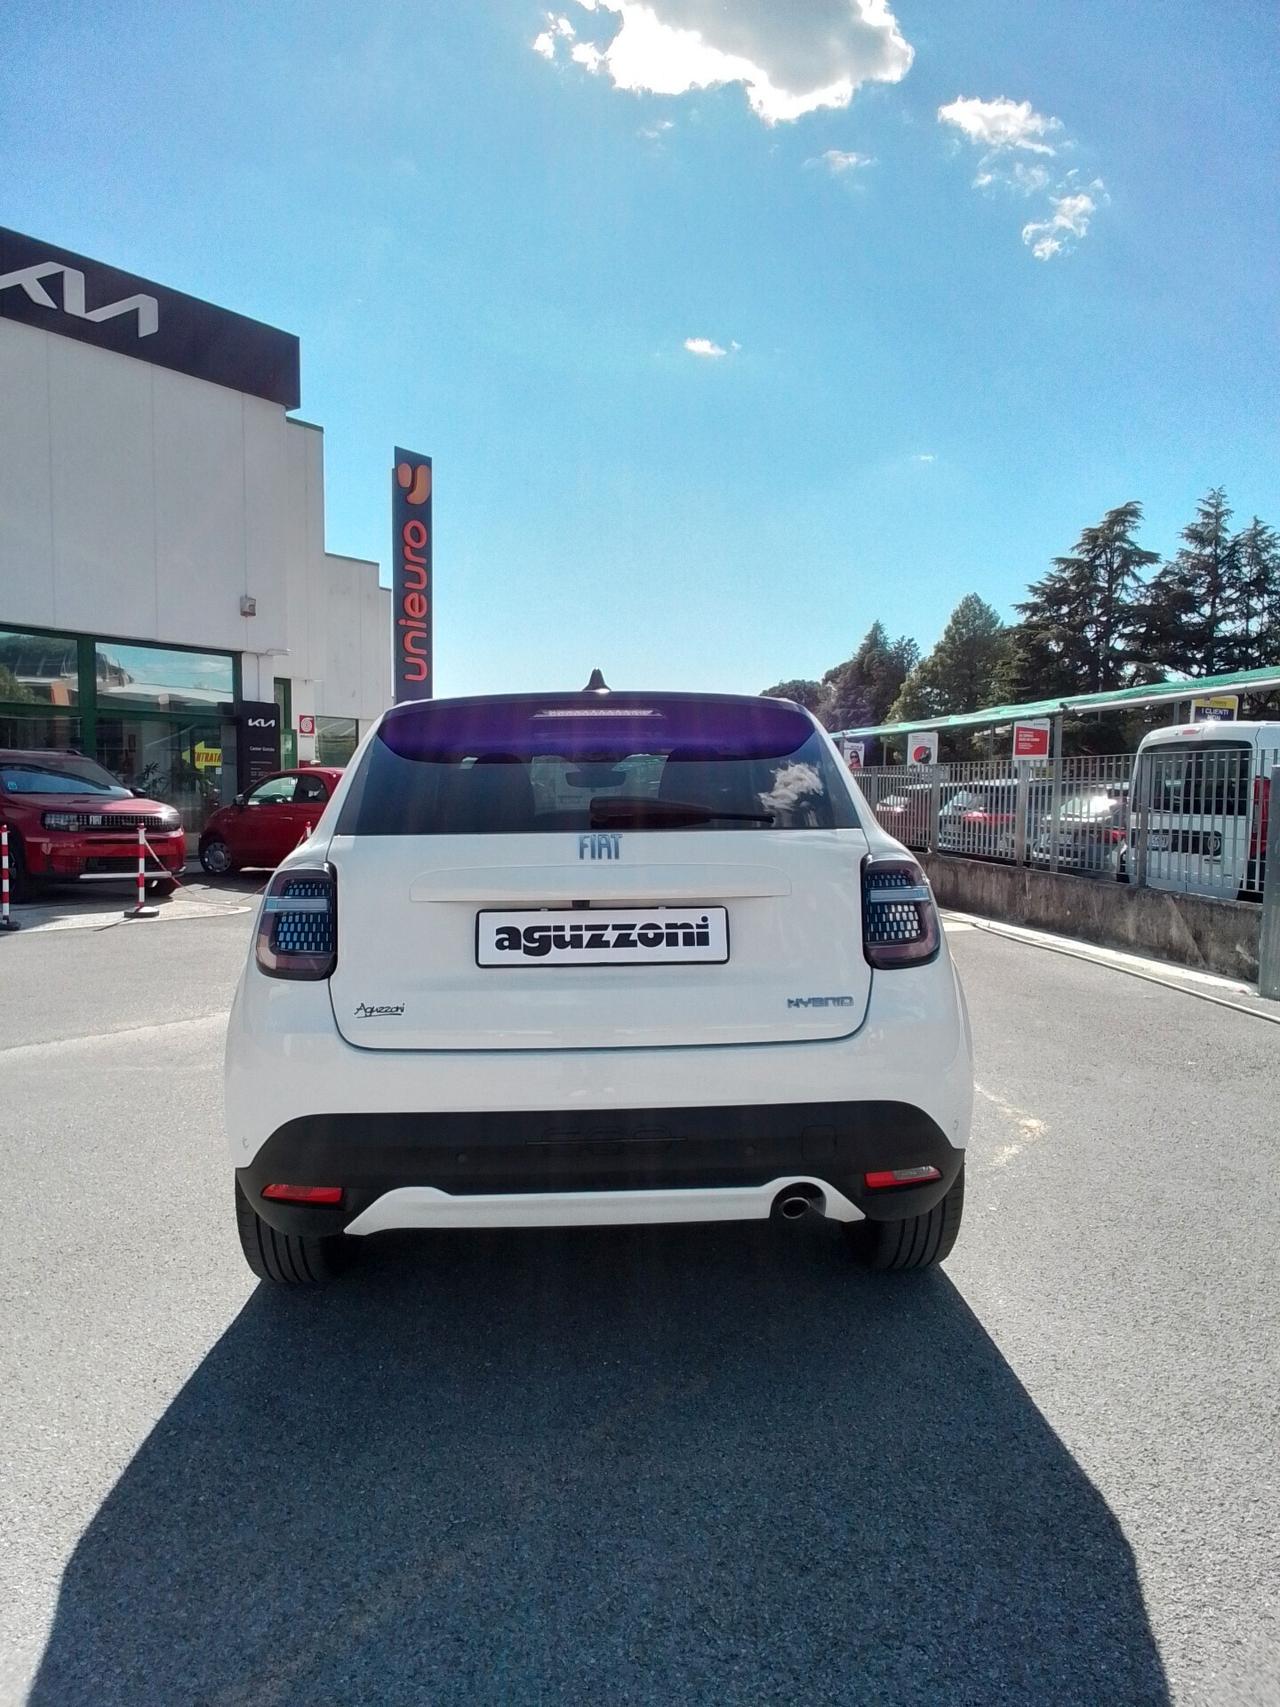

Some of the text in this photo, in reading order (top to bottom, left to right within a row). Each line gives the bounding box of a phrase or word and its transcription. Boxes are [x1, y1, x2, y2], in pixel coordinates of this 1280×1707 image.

[398, 519, 428, 681] unieuro
[1205, 708, 1229, 716] CLIENTI
[248, 718, 275, 727] KIA
[579, 834, 623, 860] FIAT
[494, 916, 710, 956] aguzzoni
[354, 1002, 405, 1018] Aguzzoni
[787, 996, 854, 1008] HYBRID
